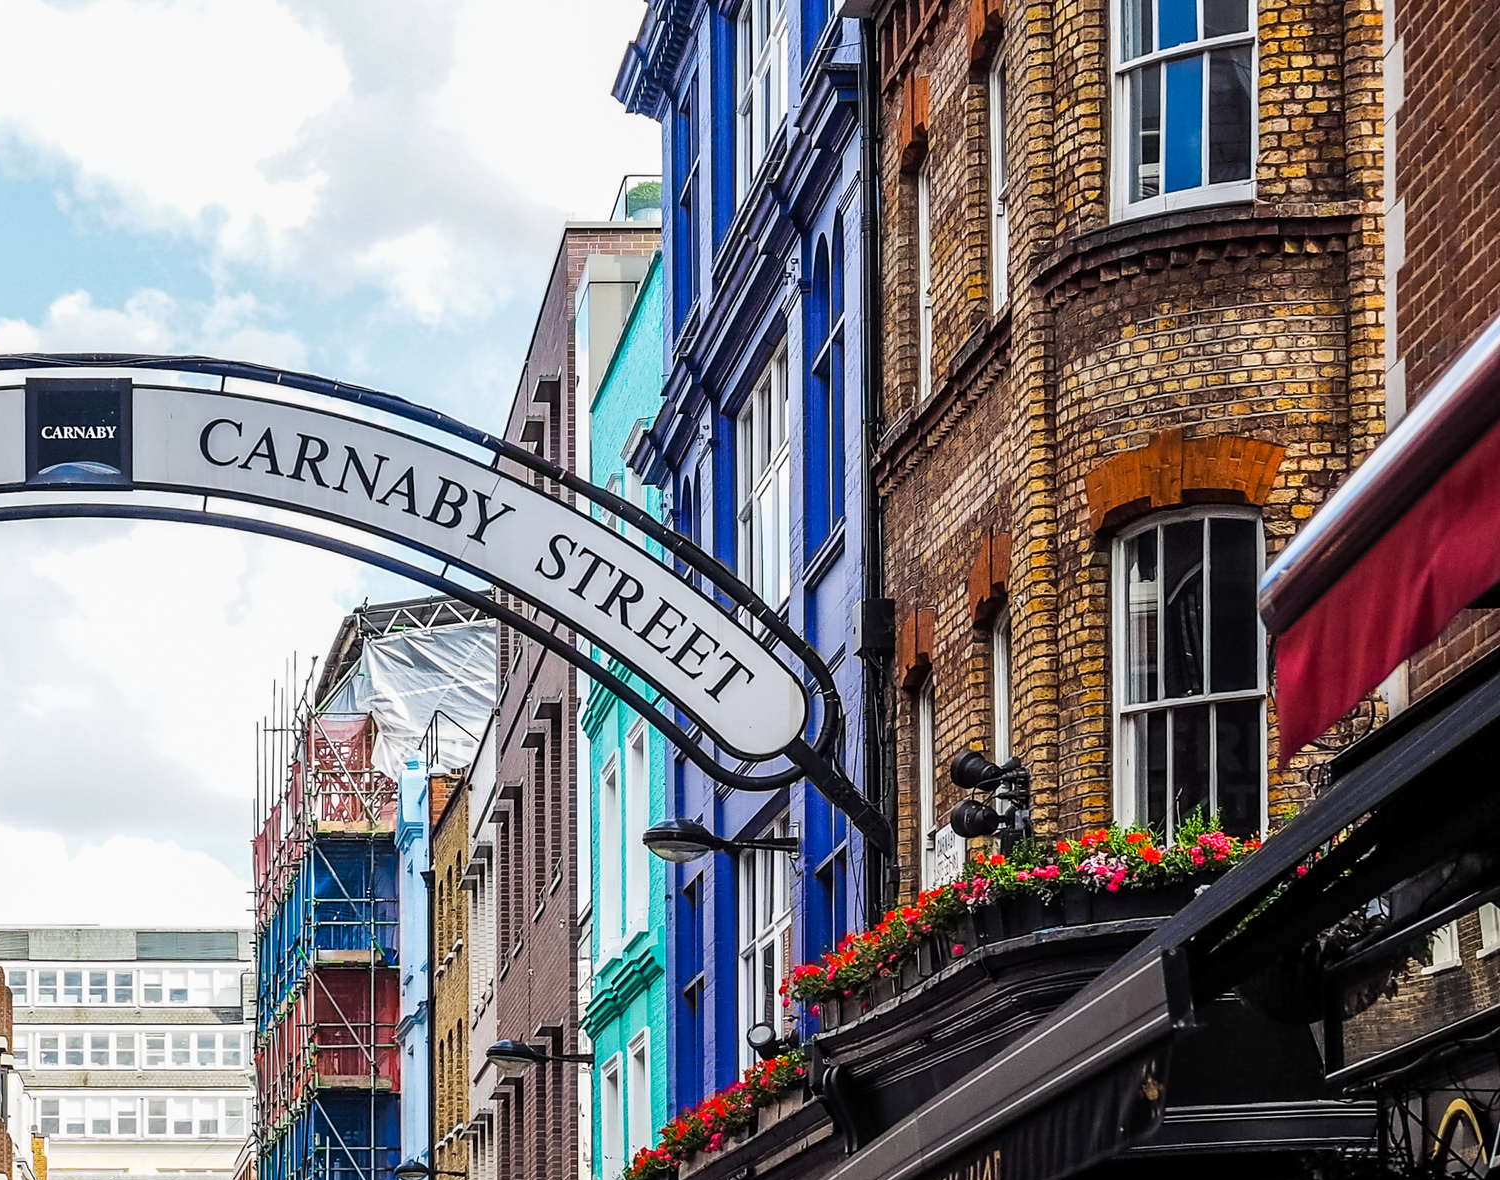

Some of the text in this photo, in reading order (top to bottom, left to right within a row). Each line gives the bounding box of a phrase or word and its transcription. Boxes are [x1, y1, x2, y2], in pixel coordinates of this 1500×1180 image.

[40, 425, 117, 440] CARNABY
[199, 417, 755, 704] CARNABY STREET
